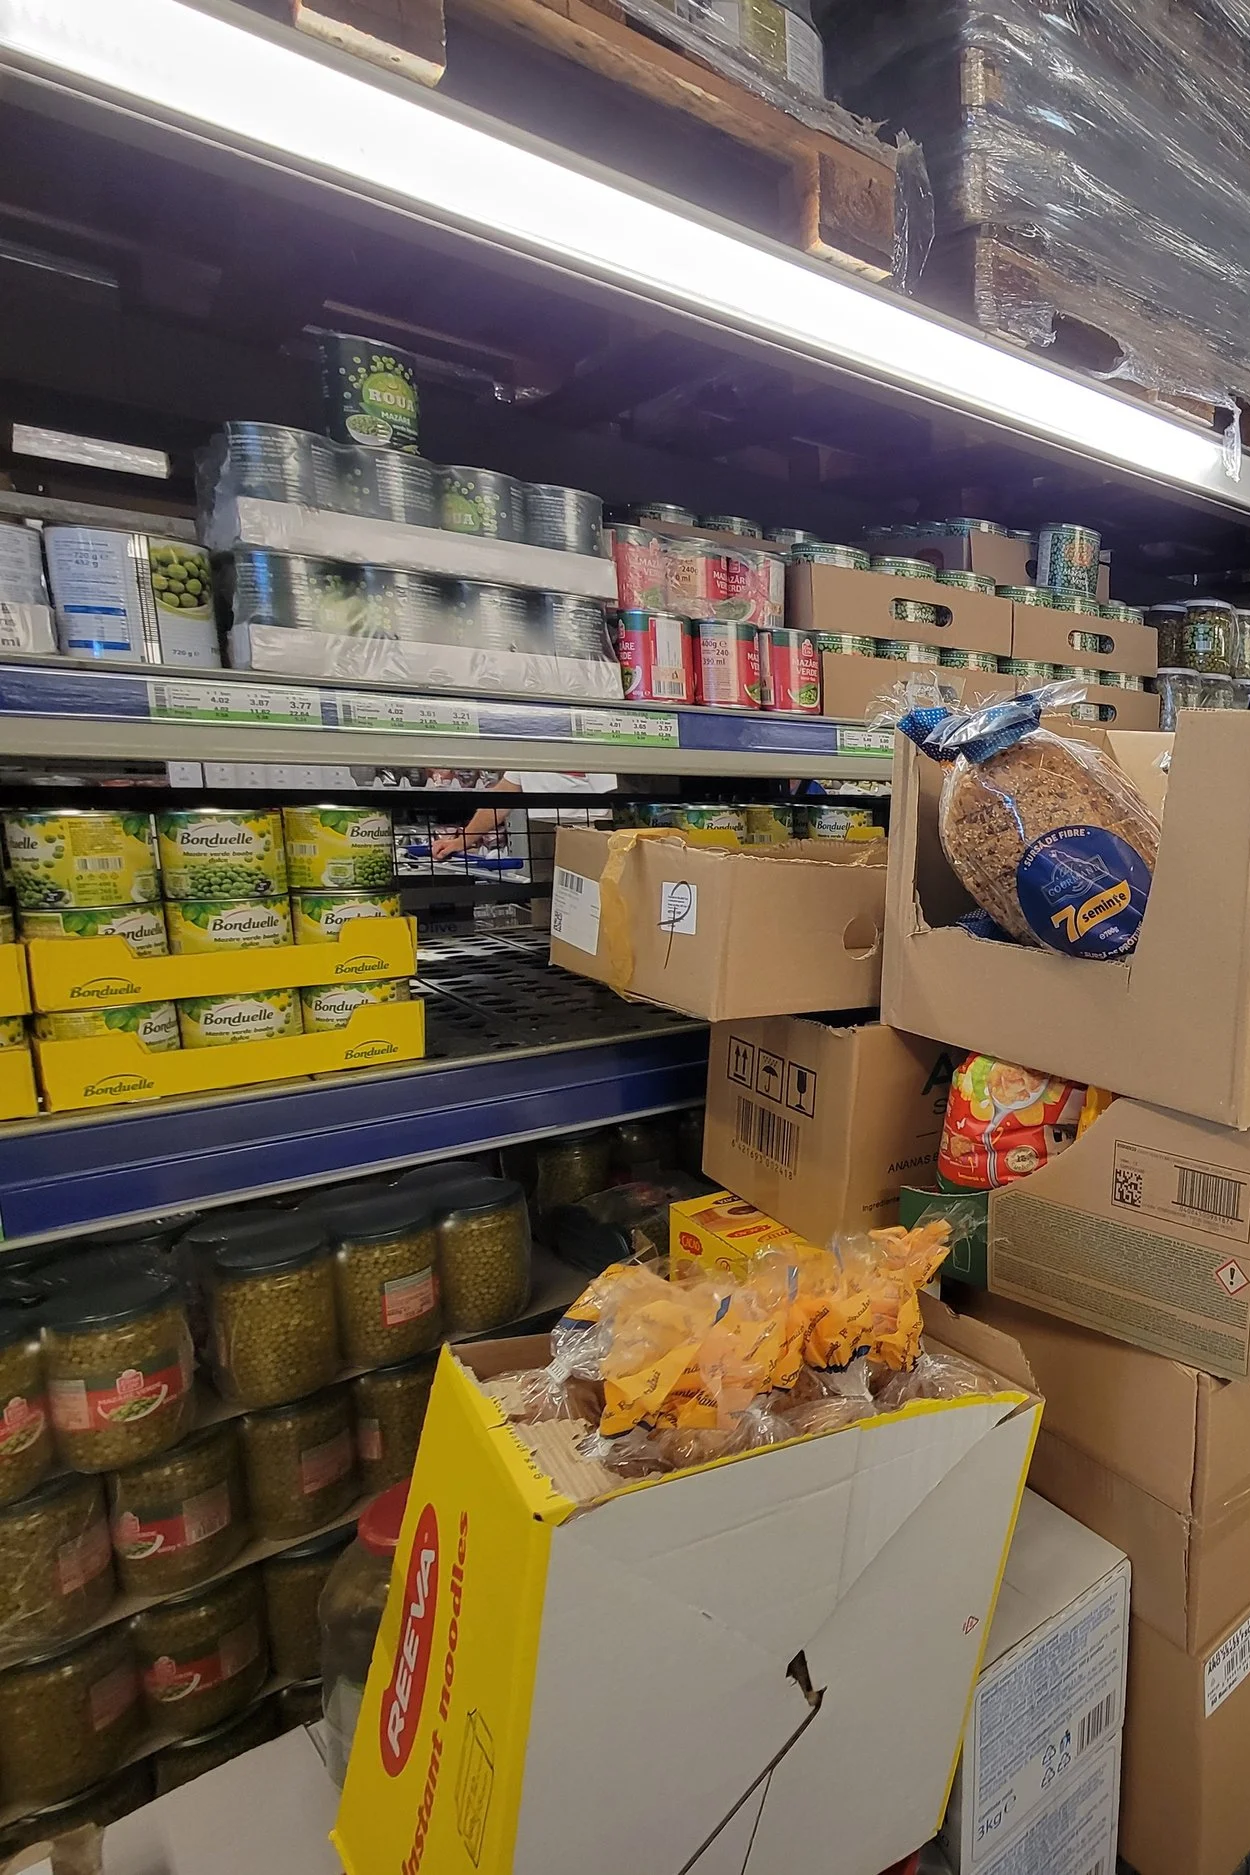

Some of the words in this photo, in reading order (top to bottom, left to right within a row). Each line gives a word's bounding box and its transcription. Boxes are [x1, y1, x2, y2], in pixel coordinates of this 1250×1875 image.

[368, 388, 415, 413] ROUA
[290, 701, 312, 710] 3.77
[180, 832, 254, 849] Bonduelle
[1045, 834, 1058, 847] DE
[1058, 828, 1086, 840] FIBRE
[1082, 891, 1127, 923] semințe
[211, 915, 280, 933] Bonduelle
[418, 921, 457, 933] Olive
[1051, 905, 1084, 943] 7
[334, 961, 390, 975] Bonduelle
[69, 982, 142, 999] Bonduelle
[203, 1007, 274, 1027] Bonduelle
[343, 1043, 399, 1060] Bonduelle
[83, 1078, 155, 1097] Bonduelle
[888, 1154, 931, 1174] ANANAS
[439, 1511, 469, 1723] noodles
[386, 1548, 436, 1759] REEVA
[400, 1728, 444, 1875] Instant
[976, 1811, 1002, 1842] 3kg
